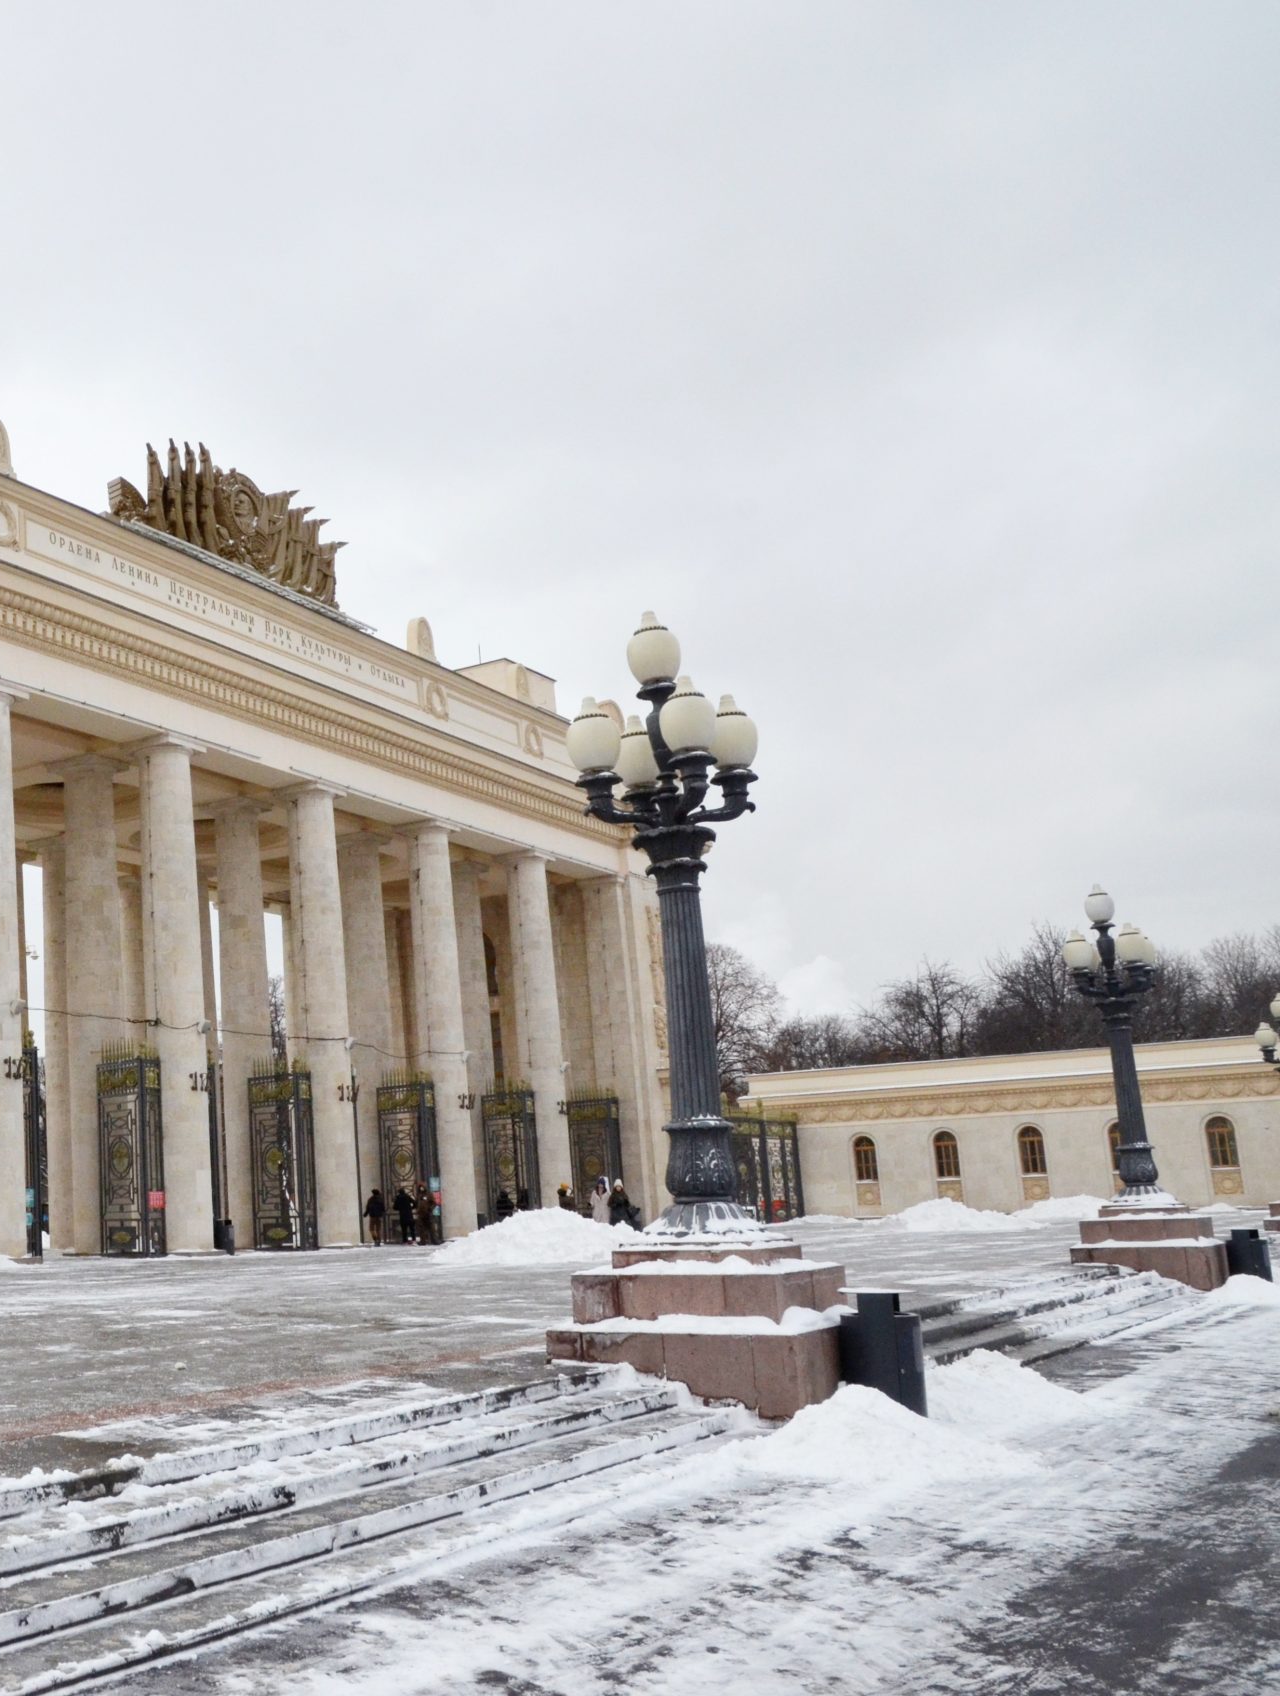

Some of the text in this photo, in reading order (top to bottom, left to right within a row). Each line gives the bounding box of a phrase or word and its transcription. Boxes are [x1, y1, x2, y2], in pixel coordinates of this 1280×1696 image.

[49, 532, 100, 564] ОРДЕНА
[112, 557, 160, 587] ЛЕНИНА
[265, 621, 292, 642] ПАРК
[301, 636, 352, 666] КУЛЬТУРЫ
[370, 664, 406, 689] ОТДЫХА
